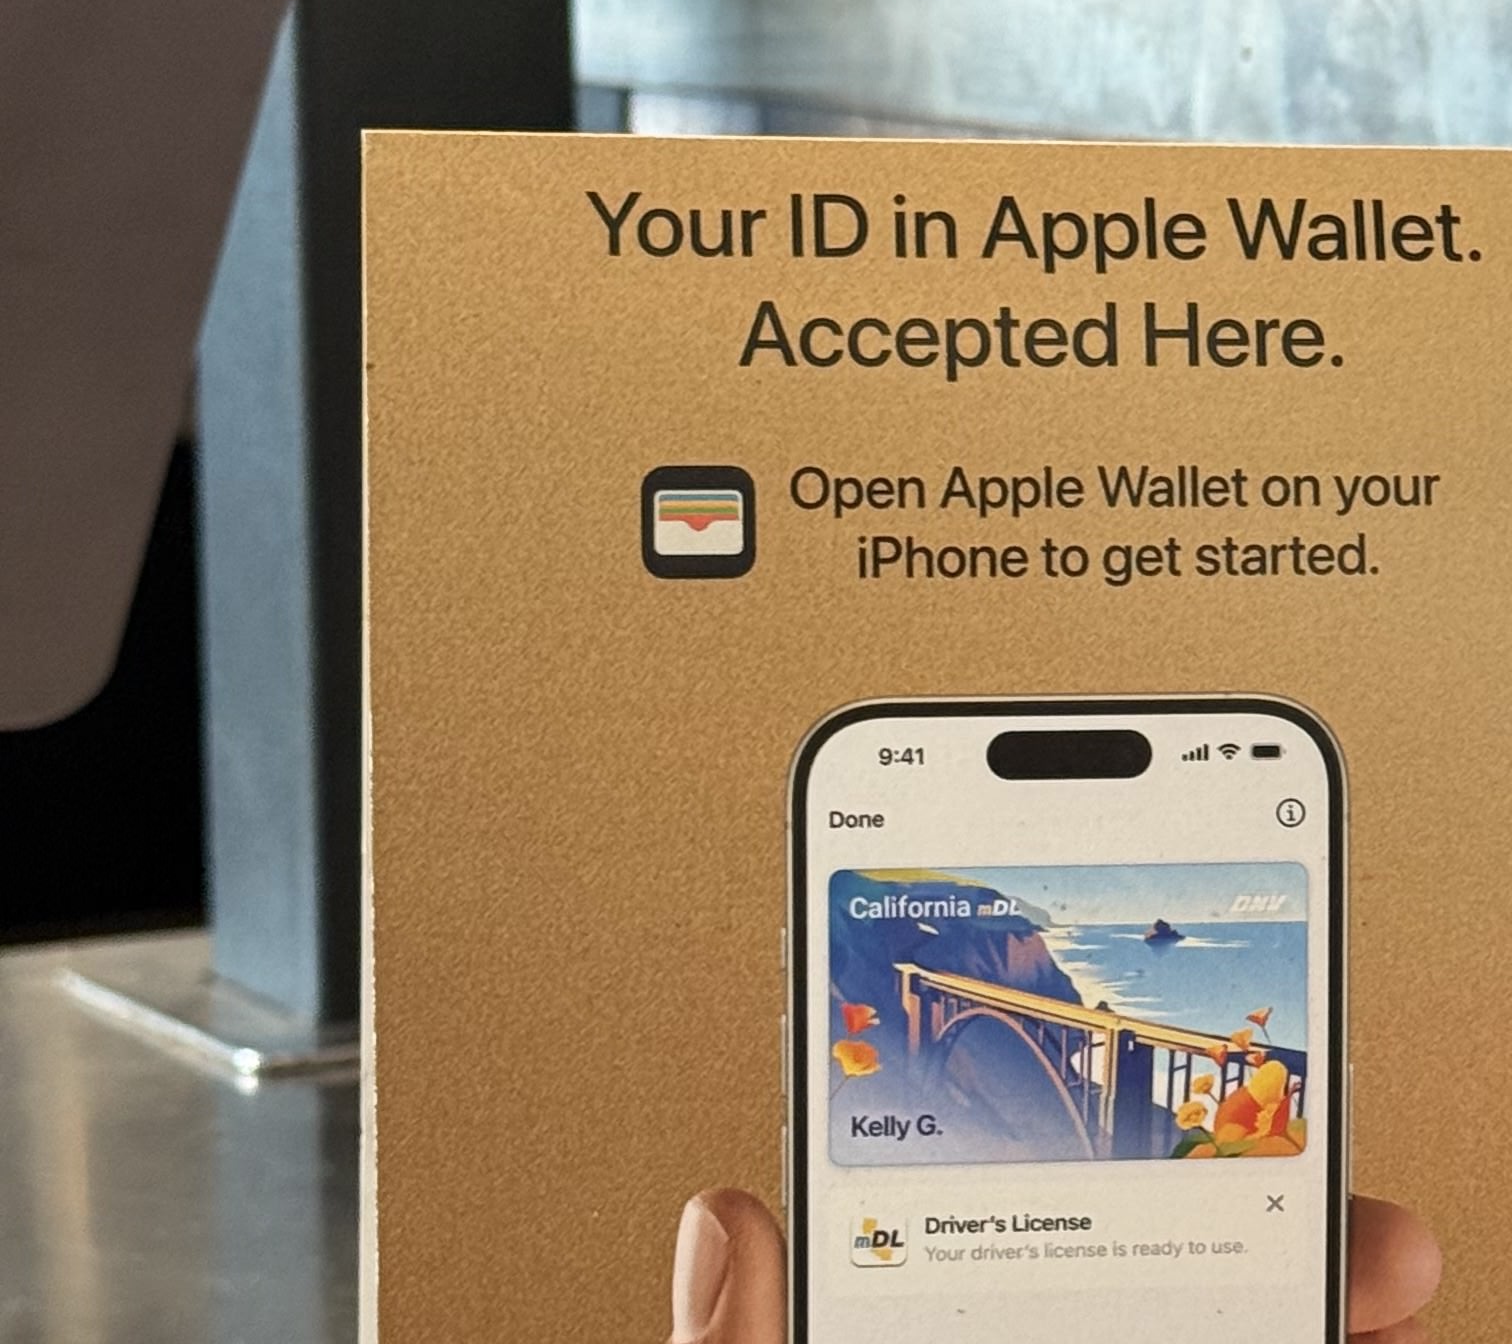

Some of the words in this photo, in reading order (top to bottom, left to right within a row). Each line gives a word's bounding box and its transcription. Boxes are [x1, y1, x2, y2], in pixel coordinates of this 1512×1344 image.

[588, 191, 766, 258] Your
[792, 194, 868, 258] ID
[894, 195, 956, 258] in
[982, 197, 1205, 273] Apple
[1228, 199, 1481, 261] Wallet.
[740, 301, 1117, 381] Accepted
[1145, 302, 1344, 367] Here.
[790, 467, 926, 518] Open
[941, 467, 1084, 518] Apple
[1097, 467, 1248, 509] Wallet
[1262, 475, 1322, 508] on
[1334, 468, 1439, 517] your
[857, 536, 1027, 580] iPhone
[1041, 540, 1089, 578] to
[1103, 539, 1180, 586] get
[1195, 535, 1378, 578] started.
[879, 748, 924, 765] 9:41
[829, 811, 884, 828] Done
[850, 897, 970, 918] California
[977, 899, 1020, 917] mDL
[1230, 895, 1287, 913] DMV
[851, 1116, 909, 1141] Kelly
[917, 1115, 943, 1136] G.
[1012, 1215, 1092, 1232] License
[854, 1230, 904, 1248] mDL
[926, 1247, 963, 1262] Your
[1045, 1243, 1107, 1259] license
[1113, 1242, 1126, 1258] is
[1133, 1242, 1182, 1259] ready
[1188, 1241, 1205, 1255] to
[1212, 1241, 1248, 1255] use.
